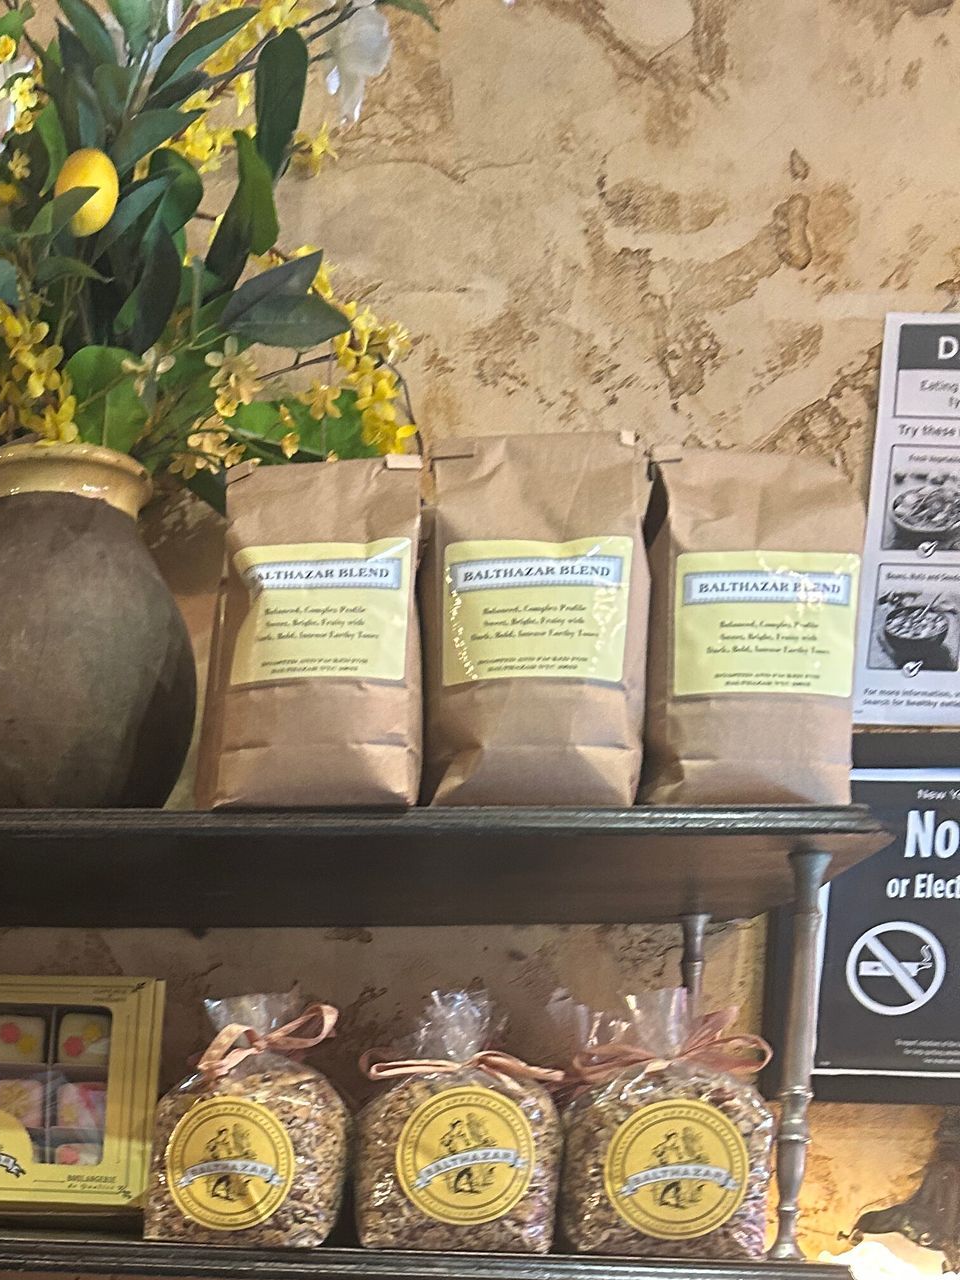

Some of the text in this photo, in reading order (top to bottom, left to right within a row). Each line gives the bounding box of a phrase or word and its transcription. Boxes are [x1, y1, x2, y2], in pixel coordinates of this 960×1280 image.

[898, 424, 956, 438] Try these
[252, 567, 390, 581] ALTHAZAR BLEND
[463, 565, 610, 582] BALTHAZAR BLEND
[698, 582, 789, 593] BALTHAZAR
[917, 789, 947, 800] New
[904, 810, 960, 859] No
[886, 878, 911, 898] or
[191, 1162, 270, 1176] BALTHAZAR
[426, 1153, 512, 1175] BALTHAZAR
[633, 1169, 723, 1184] BALTHAZAR
